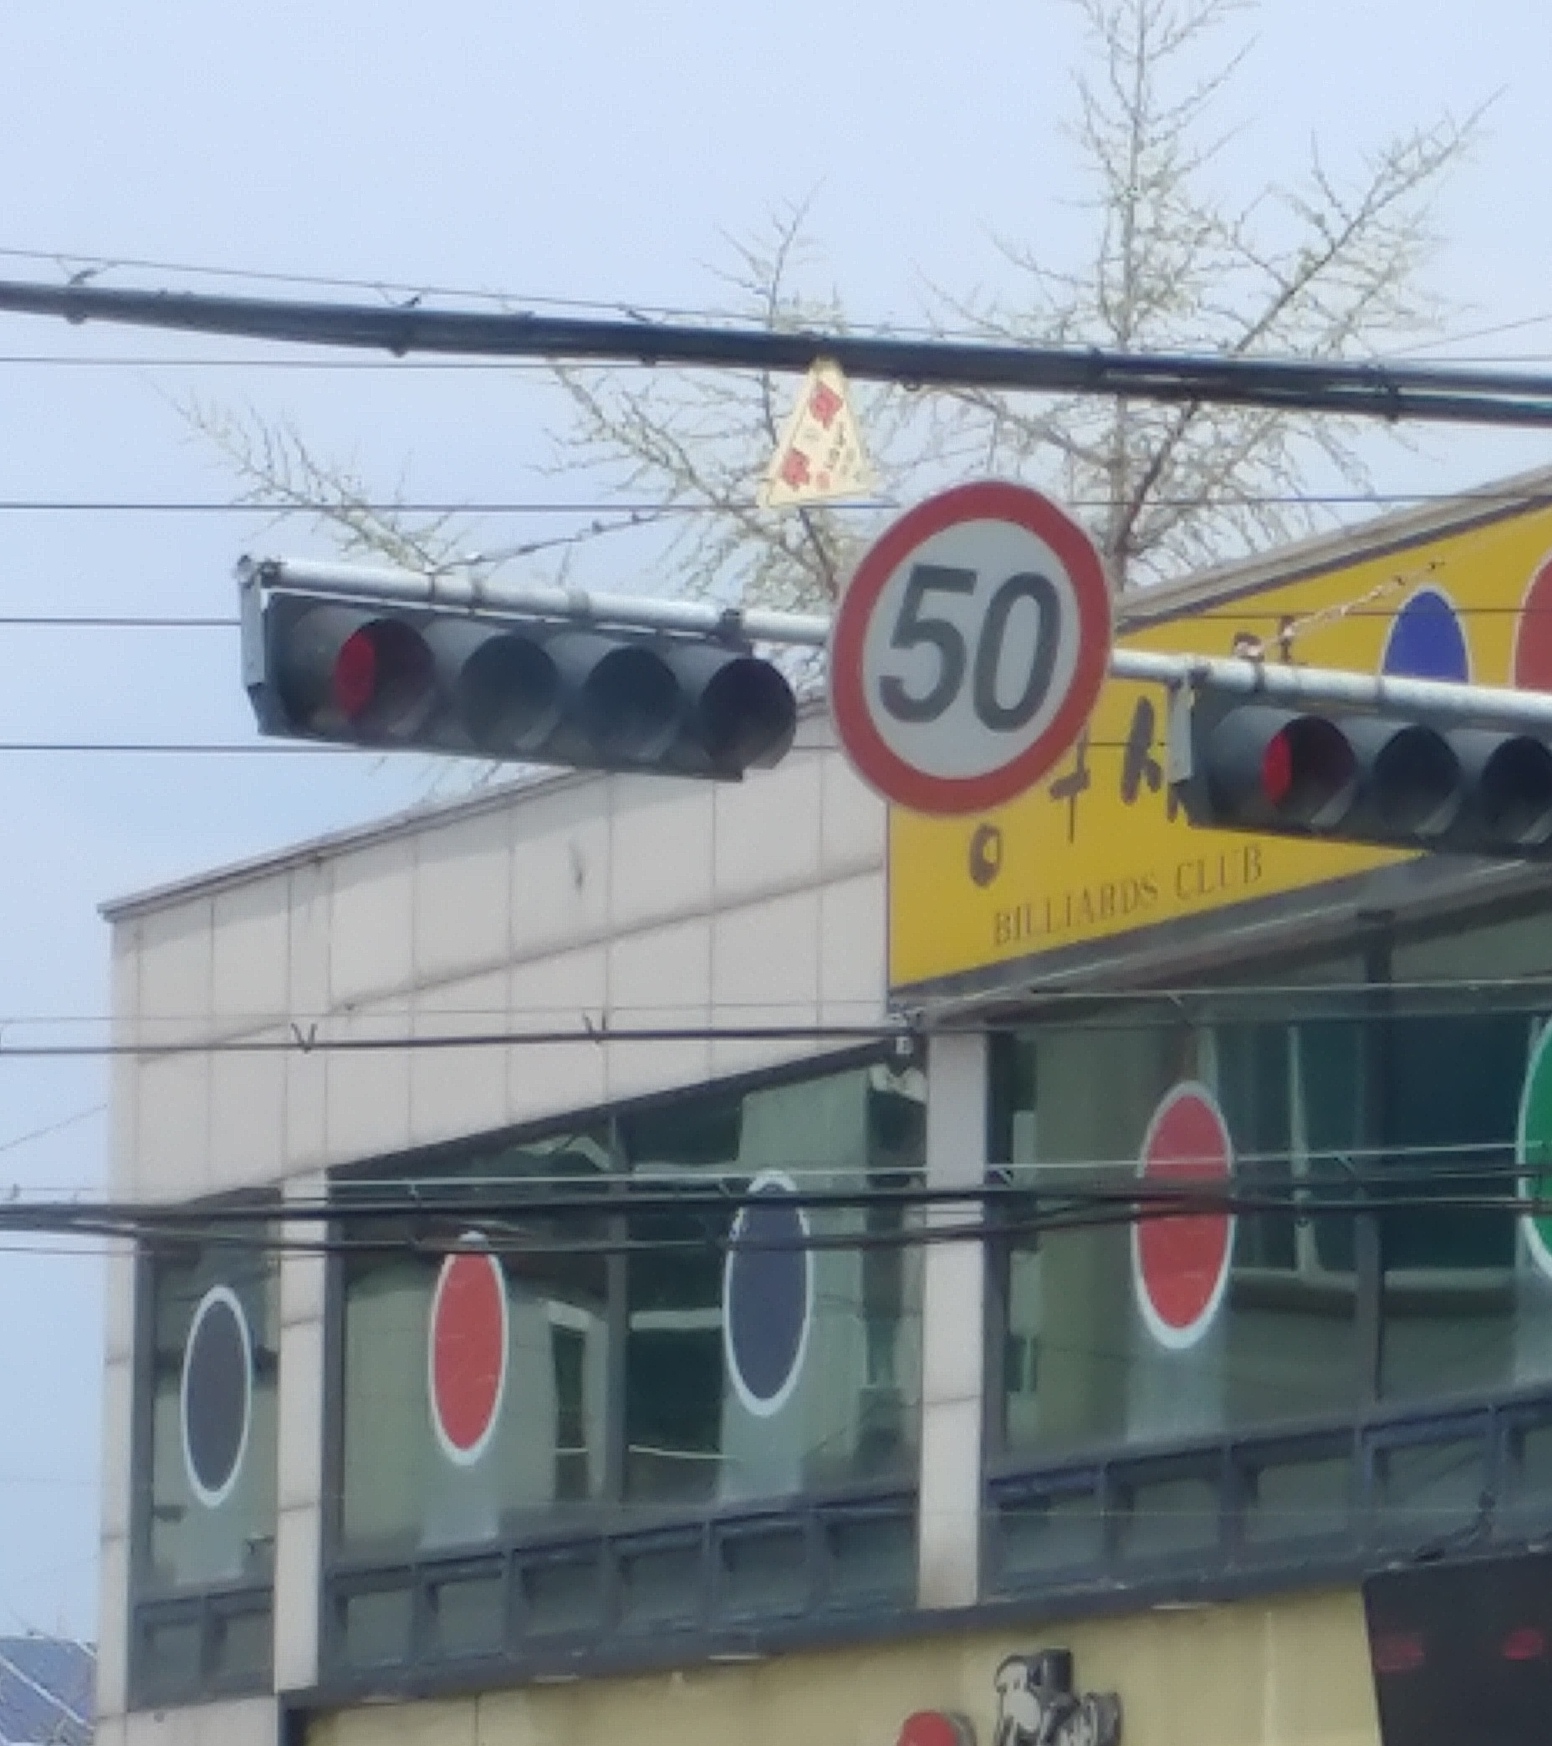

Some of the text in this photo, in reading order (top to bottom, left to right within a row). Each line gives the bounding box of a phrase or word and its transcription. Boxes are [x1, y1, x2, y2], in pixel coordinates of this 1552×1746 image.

[877, 563, 1064, 734] 50
[992, 845, 1264, 947] BILLIARDS CLUB
